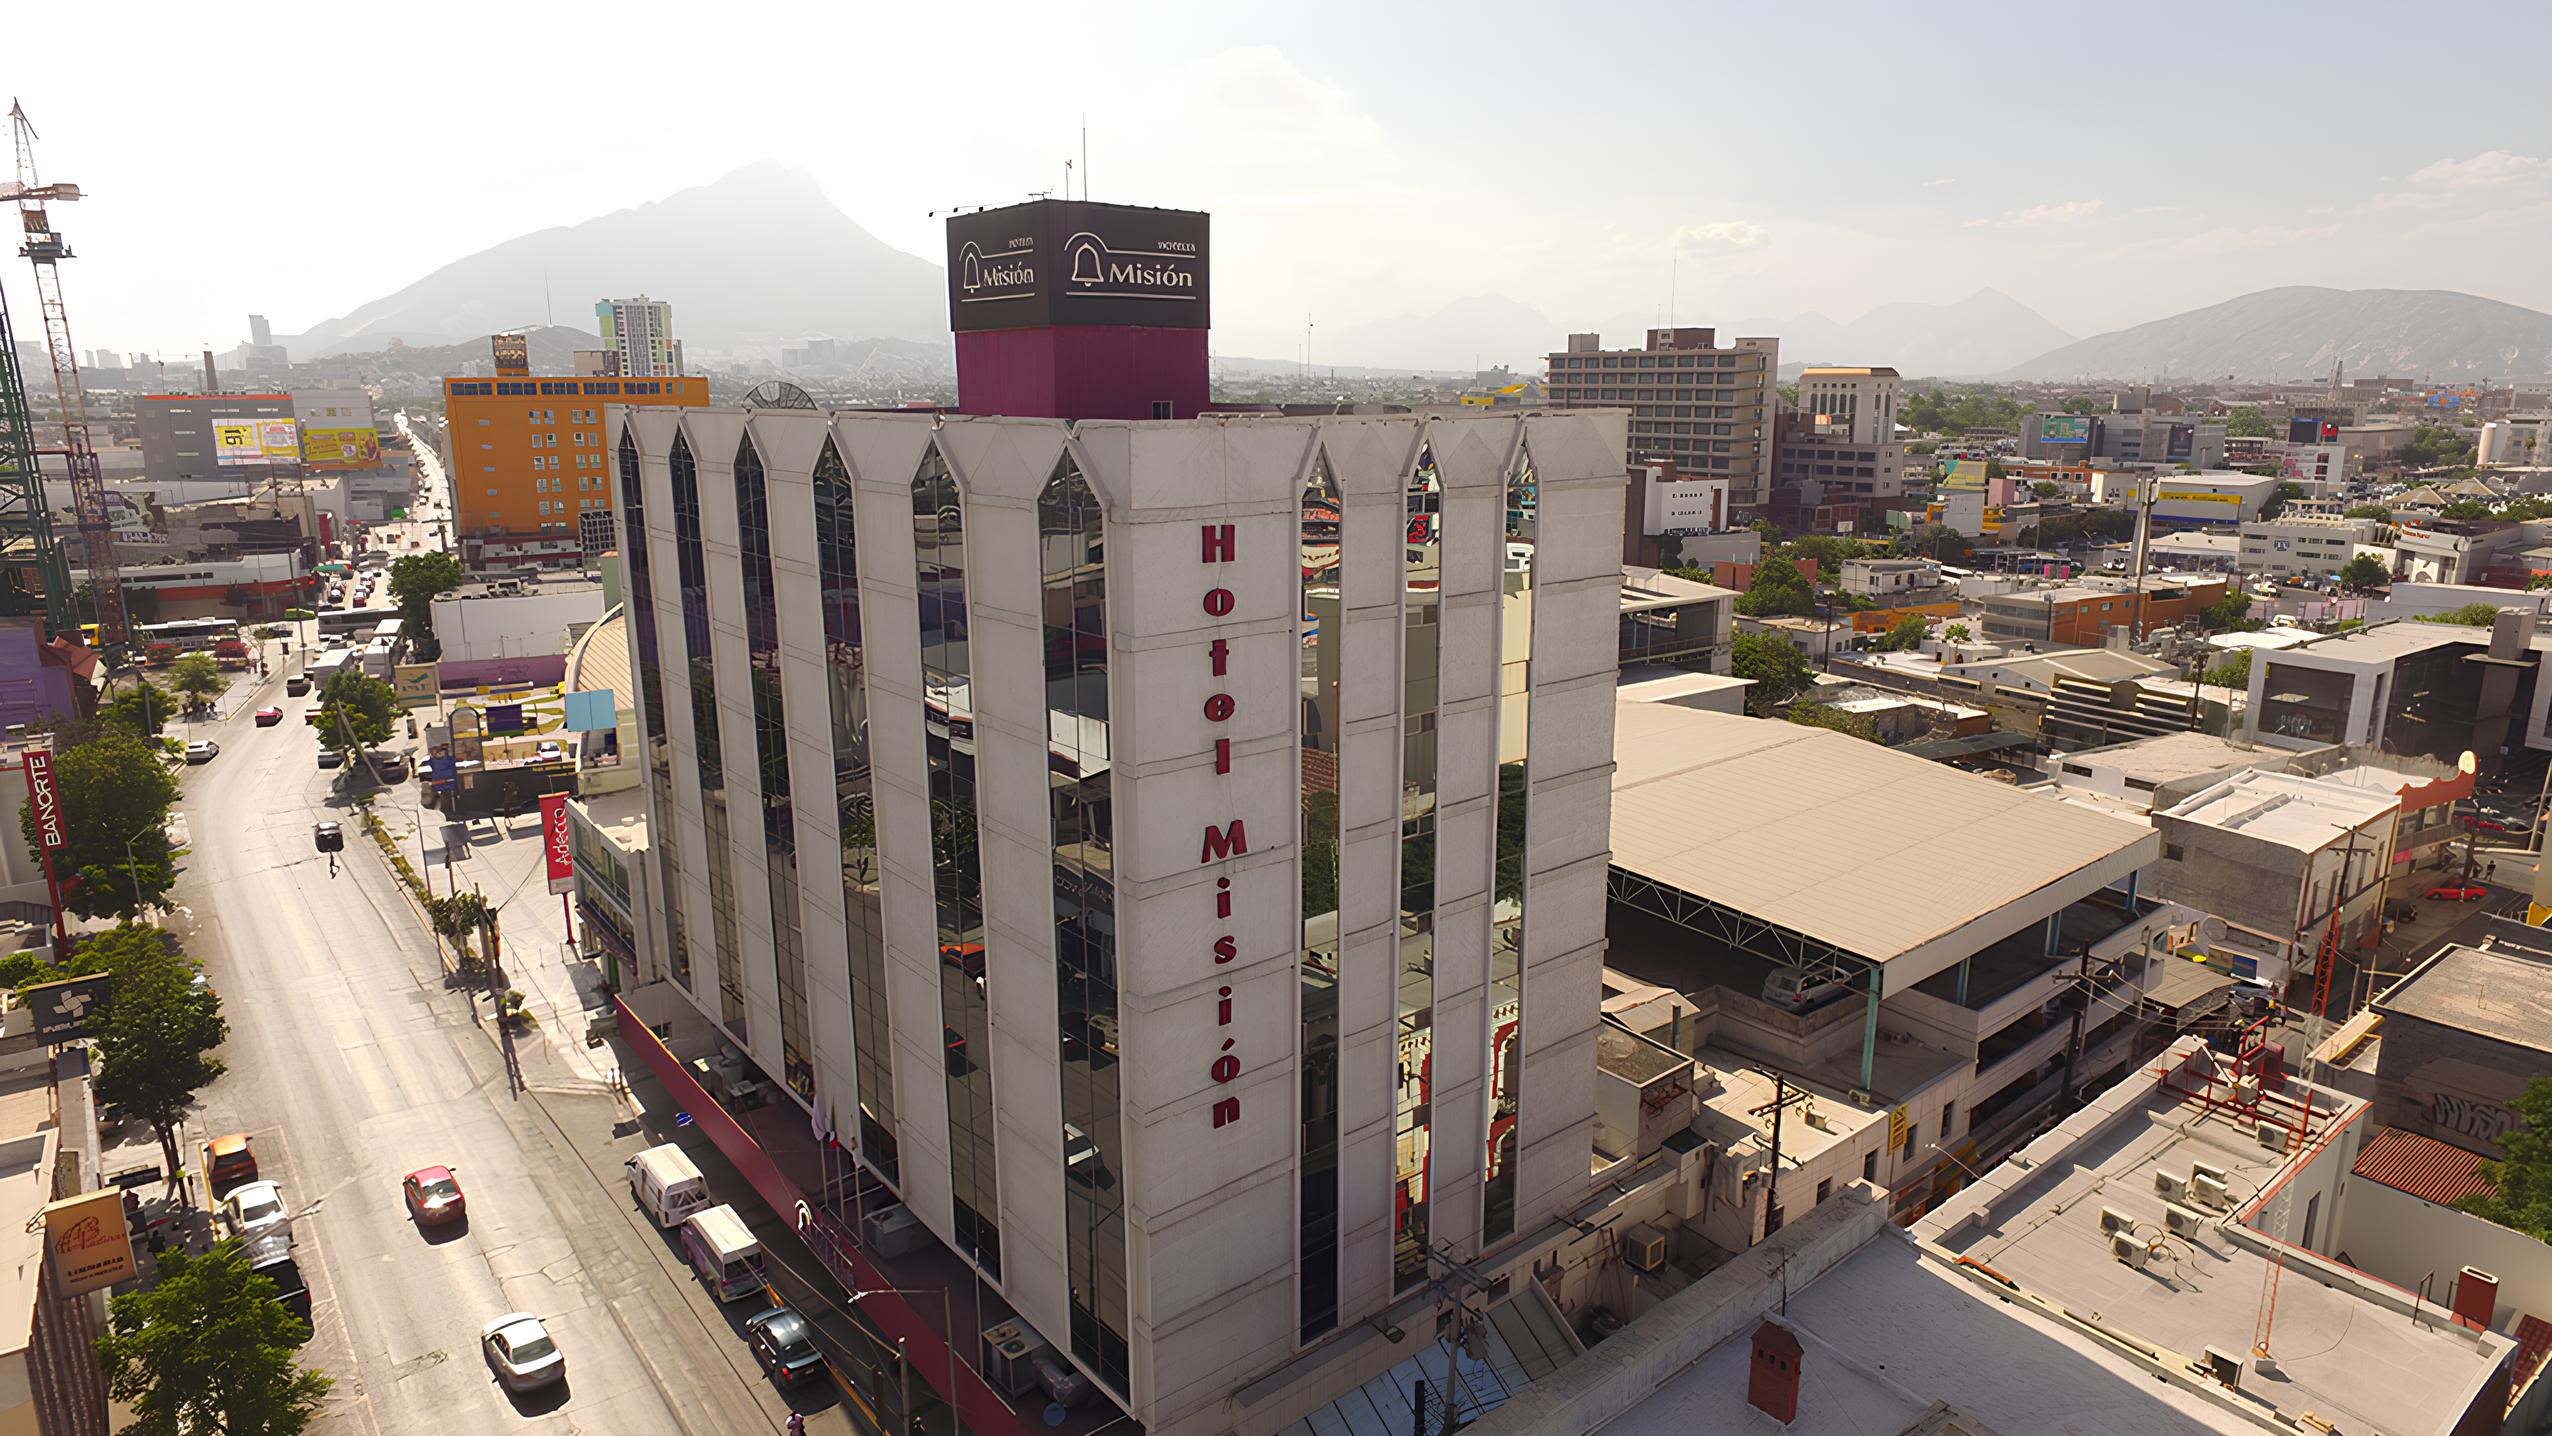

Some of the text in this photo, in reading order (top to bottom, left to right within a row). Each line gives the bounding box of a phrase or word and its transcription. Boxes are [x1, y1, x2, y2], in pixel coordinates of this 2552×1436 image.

[983, 261, 1034, 288] Misión
[1109, 263, 1193, 287] Misión
[29, 756, 62, 847] BANORTE
[1201, 524, 1248, 1129] Hotel Misión
